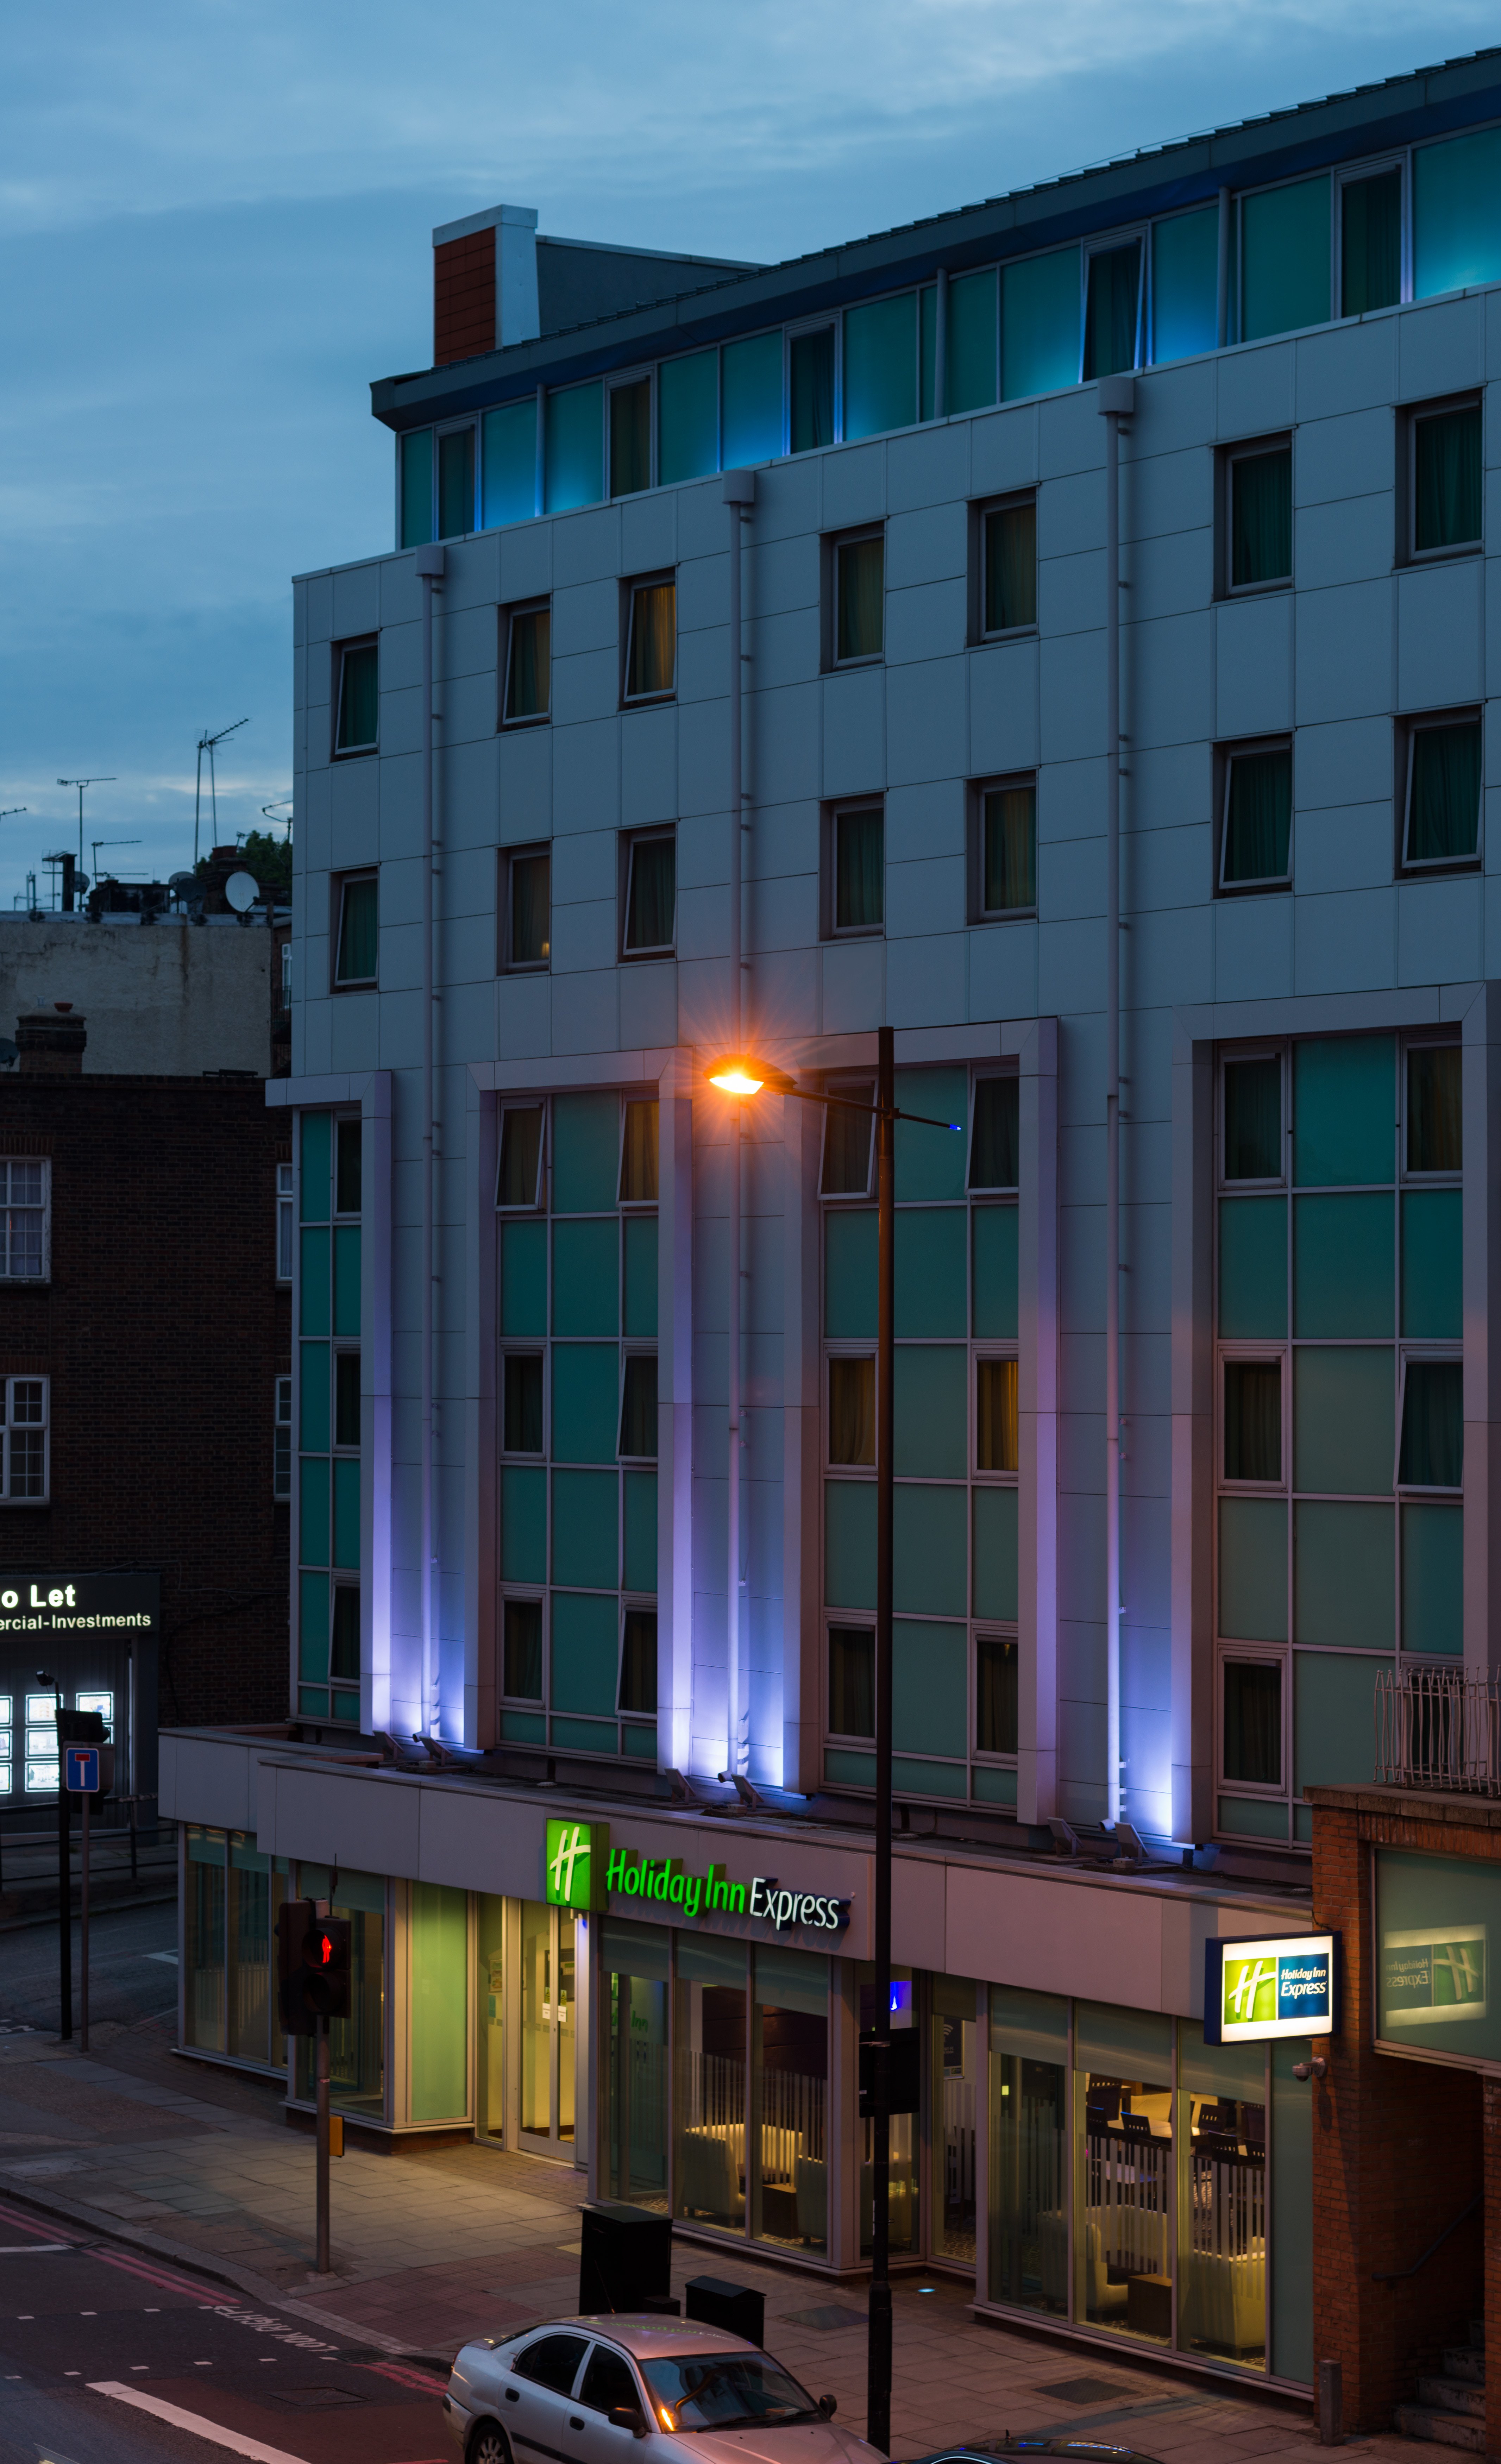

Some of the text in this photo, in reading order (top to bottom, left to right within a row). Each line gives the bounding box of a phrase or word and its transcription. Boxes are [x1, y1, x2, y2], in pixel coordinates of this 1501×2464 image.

[1, 1584, 76, 1608] o Let
[605, 1848, 839, 1931] Holiday Inn Express
[1281, 1967, 1326, 1980] Holiday Inn
[1281, 1981, 1326, 1999] Express
[214, 2310, 340, 2352] LOOK RIGHT
